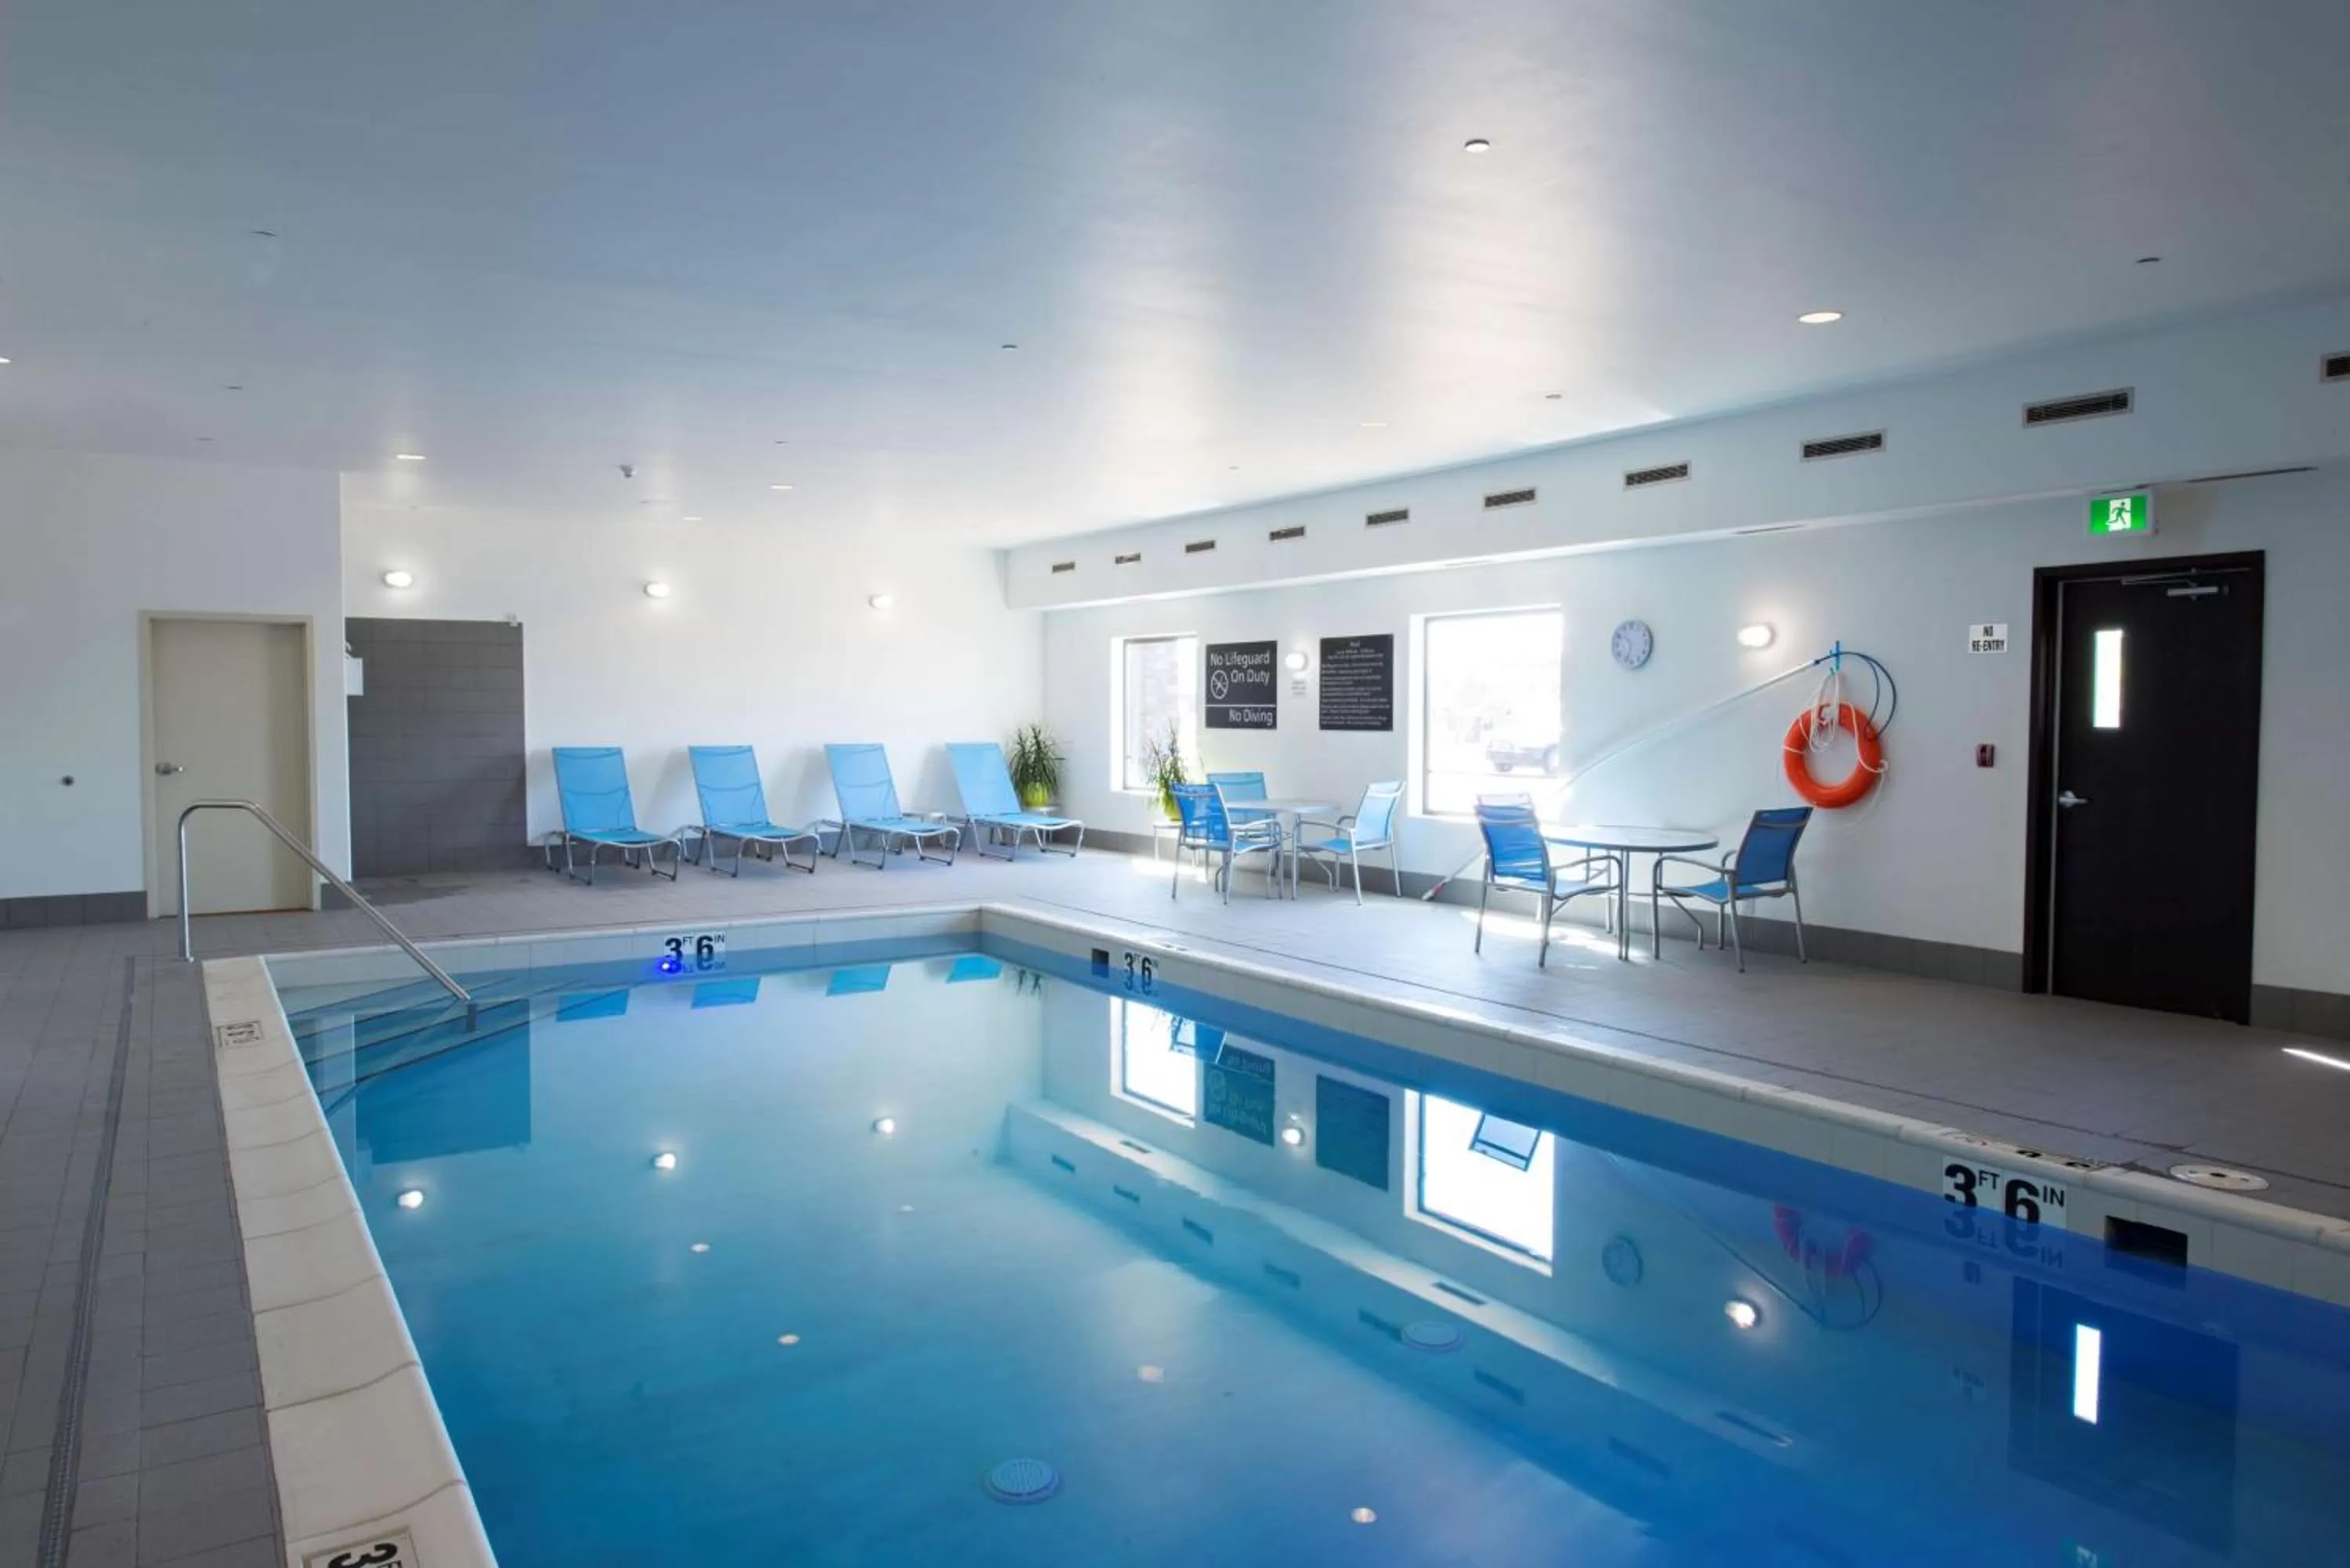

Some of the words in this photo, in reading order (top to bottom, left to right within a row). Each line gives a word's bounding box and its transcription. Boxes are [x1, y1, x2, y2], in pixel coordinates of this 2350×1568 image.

[1209, 652, 1223, 667] No
[1225, 650, 1270, 668] Lifeguard
[1231, 669, 1245, 683] On
[1247, 669, 1270, 686] Duty
[1228, 708, 1242, 722] No
[1244, 708, 1273, 726] Diving
[1943, 1164, 1977, 1208] 3
[1978, 1170, 2000, 1190] FT
[2005, 1179, 2041, 1224] 6
[2042, 1185, 2065, 1207] IN
